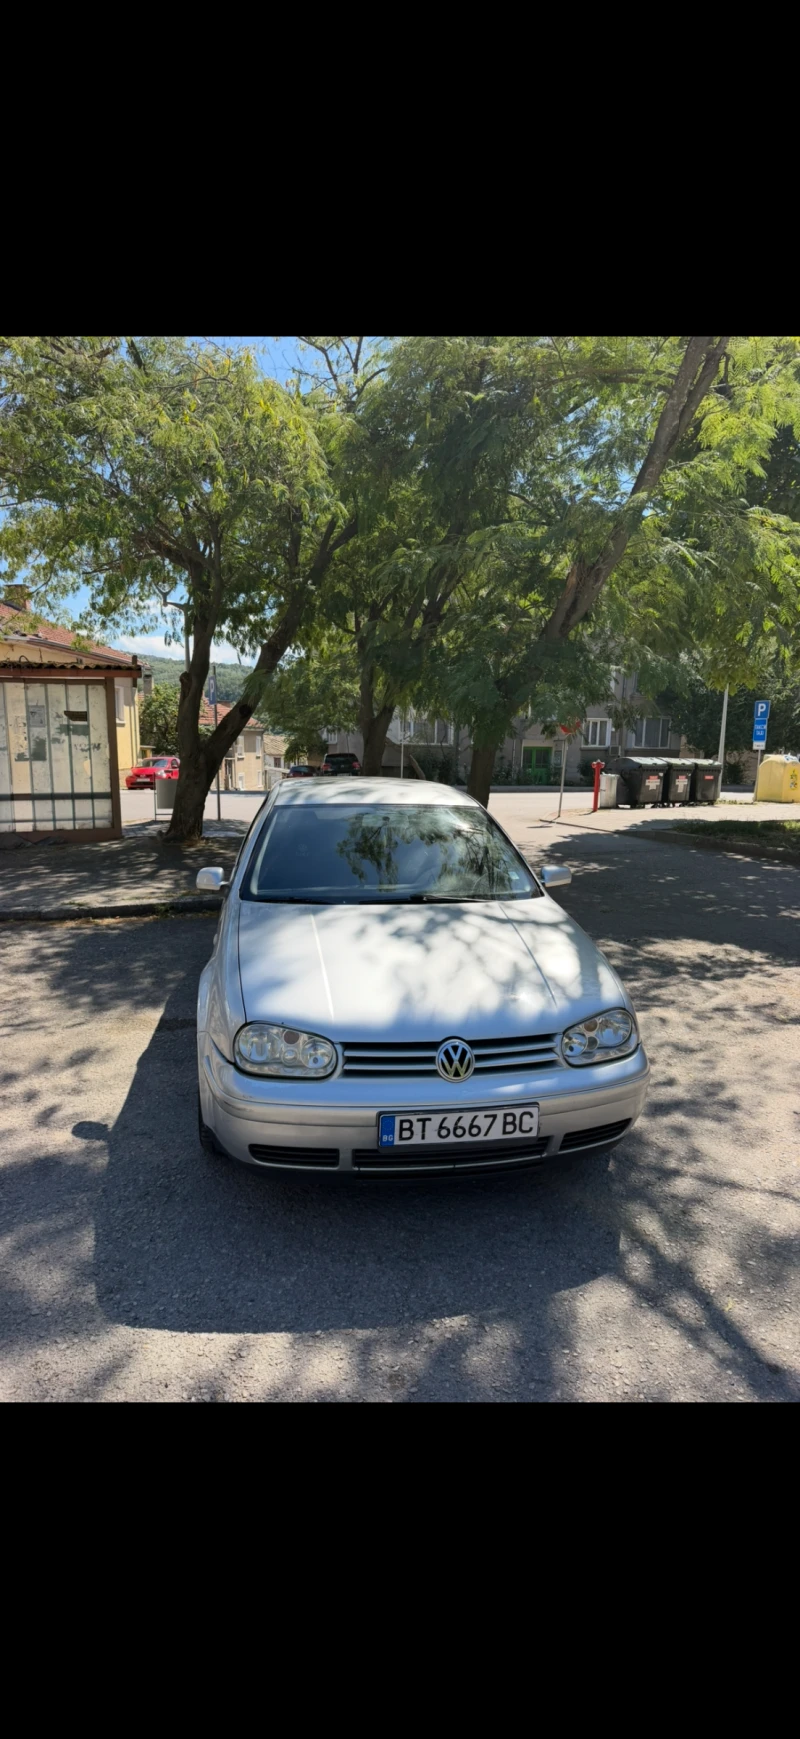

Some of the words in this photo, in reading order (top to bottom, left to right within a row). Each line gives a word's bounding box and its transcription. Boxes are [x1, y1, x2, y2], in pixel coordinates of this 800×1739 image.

[209, 679, 215, 701] P
[757, 703, 767, 717] P
[438, 1042, 473, 1079] VW
[398, 1117, 432, 1142] BT
[437, 1114, 498, 1139] 6667
[502, 1111, 534, 1135] BC
[382, 1134, 394, 1142] BG
